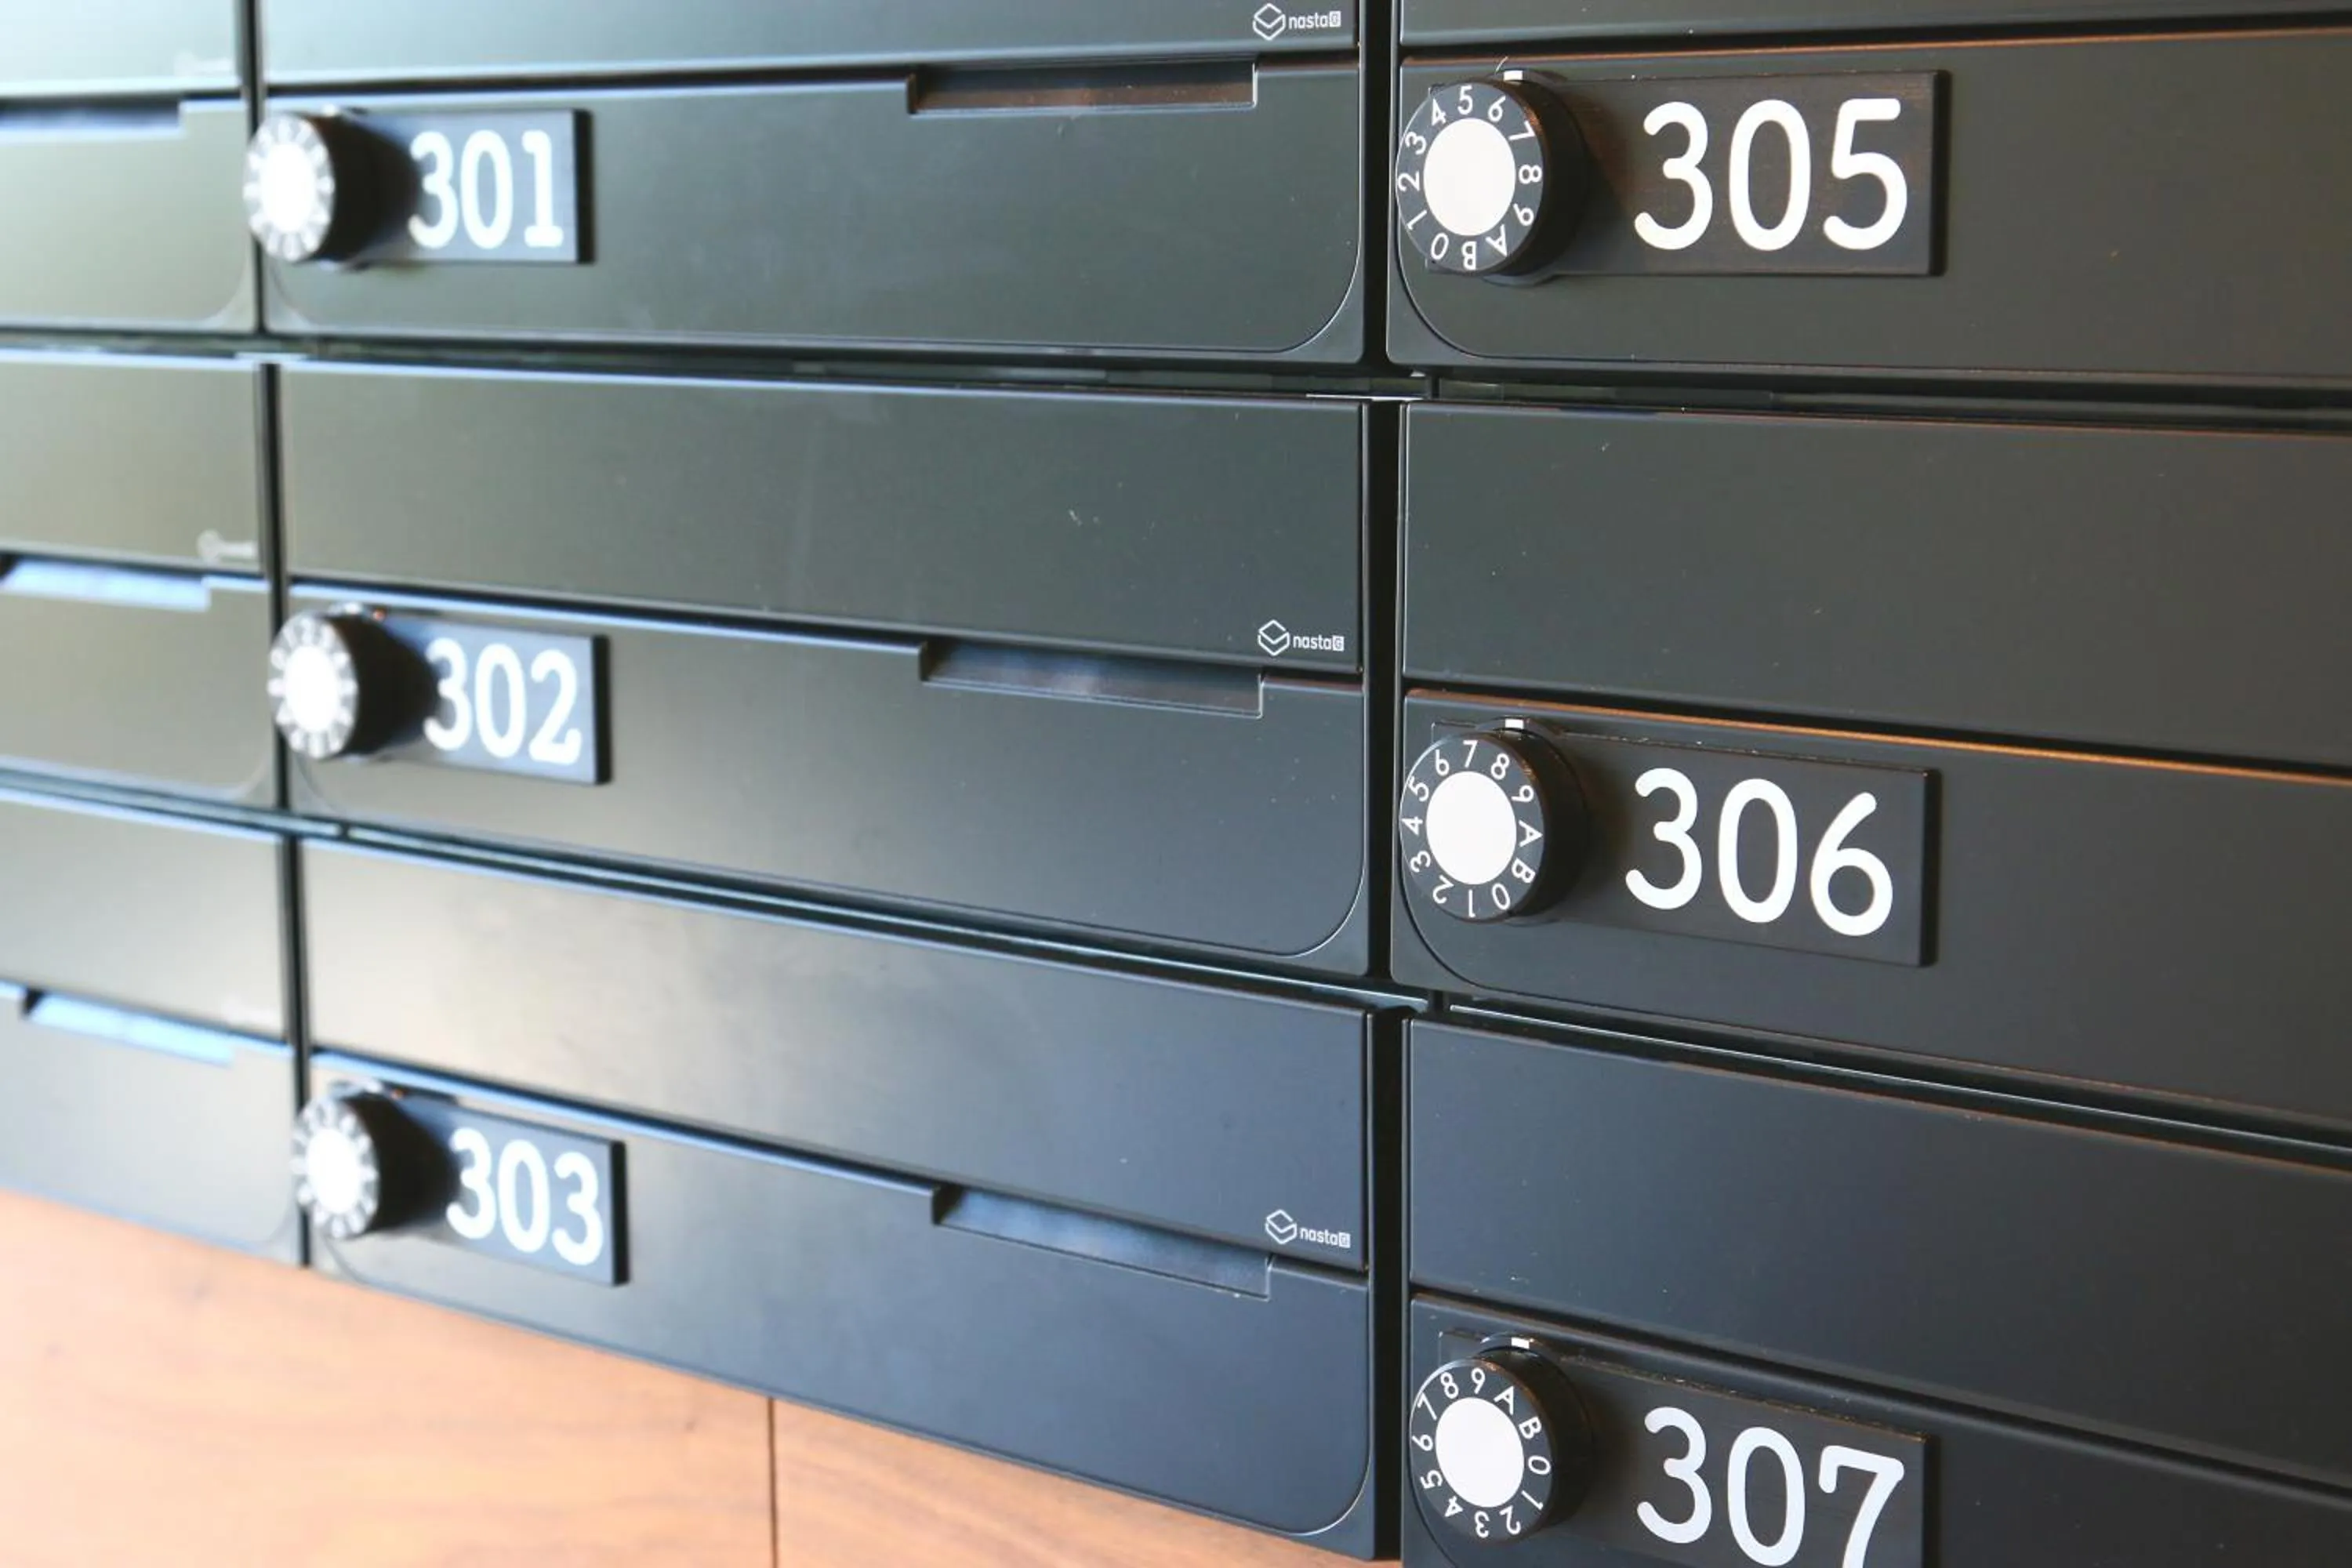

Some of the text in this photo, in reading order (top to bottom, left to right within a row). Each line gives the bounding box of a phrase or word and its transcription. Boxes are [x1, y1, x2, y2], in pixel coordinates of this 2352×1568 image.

[408, 129, 564, 249] 301
[1635, 99, 1907, 250] 305
[423, 637, 582, 766] 302
[1626, 768, 1893, 935] 306
[446, 1127, 604, 1265] 303
[1637, 1407, 1904, 1568] 307
